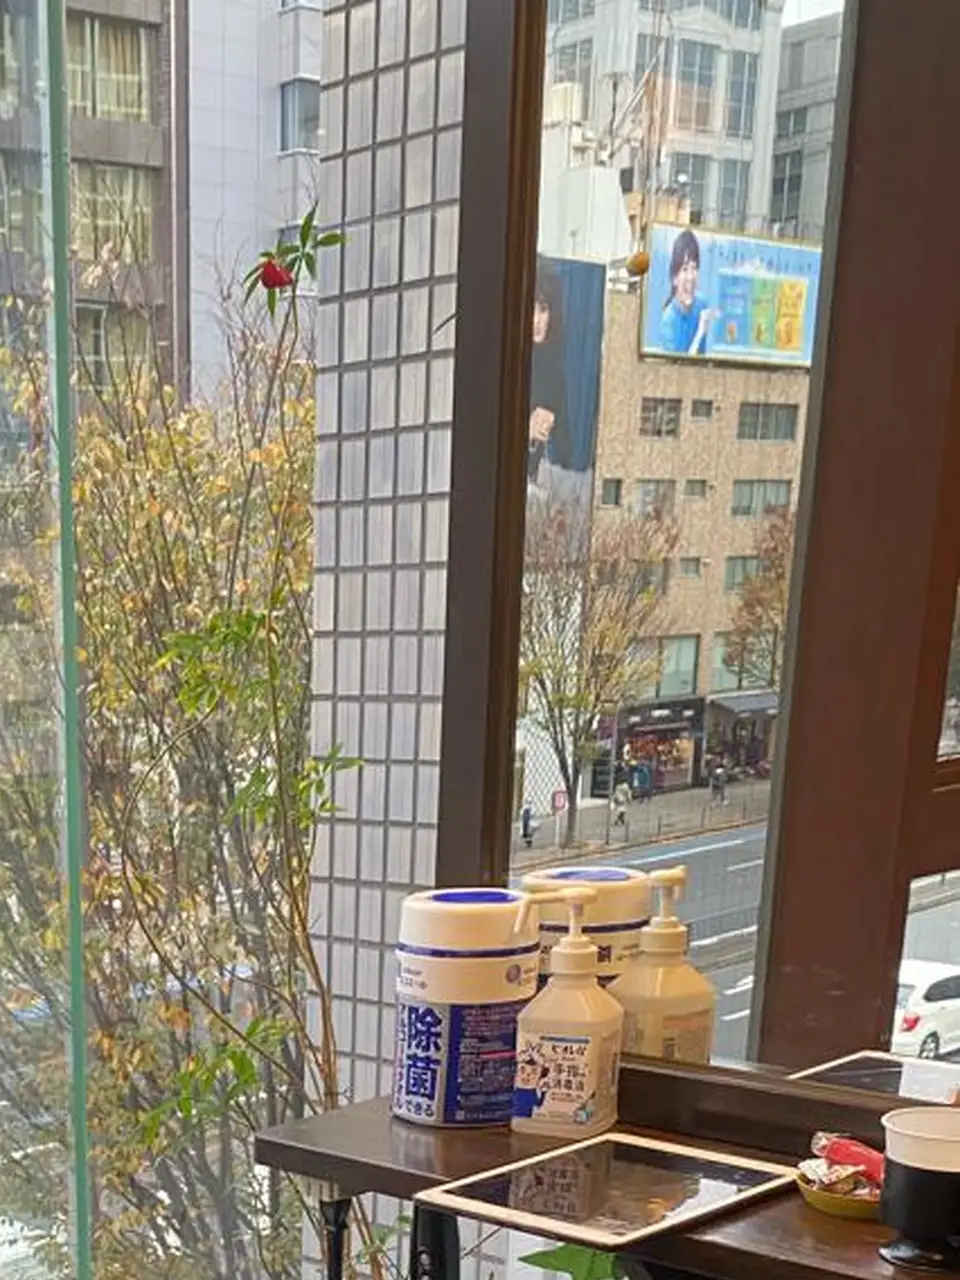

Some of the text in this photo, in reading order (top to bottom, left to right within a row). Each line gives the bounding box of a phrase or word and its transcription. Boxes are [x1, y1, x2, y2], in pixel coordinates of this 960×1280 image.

[405, 1005, 443, 1101] 除菌
[405, 1099, 435, 1119] できる
